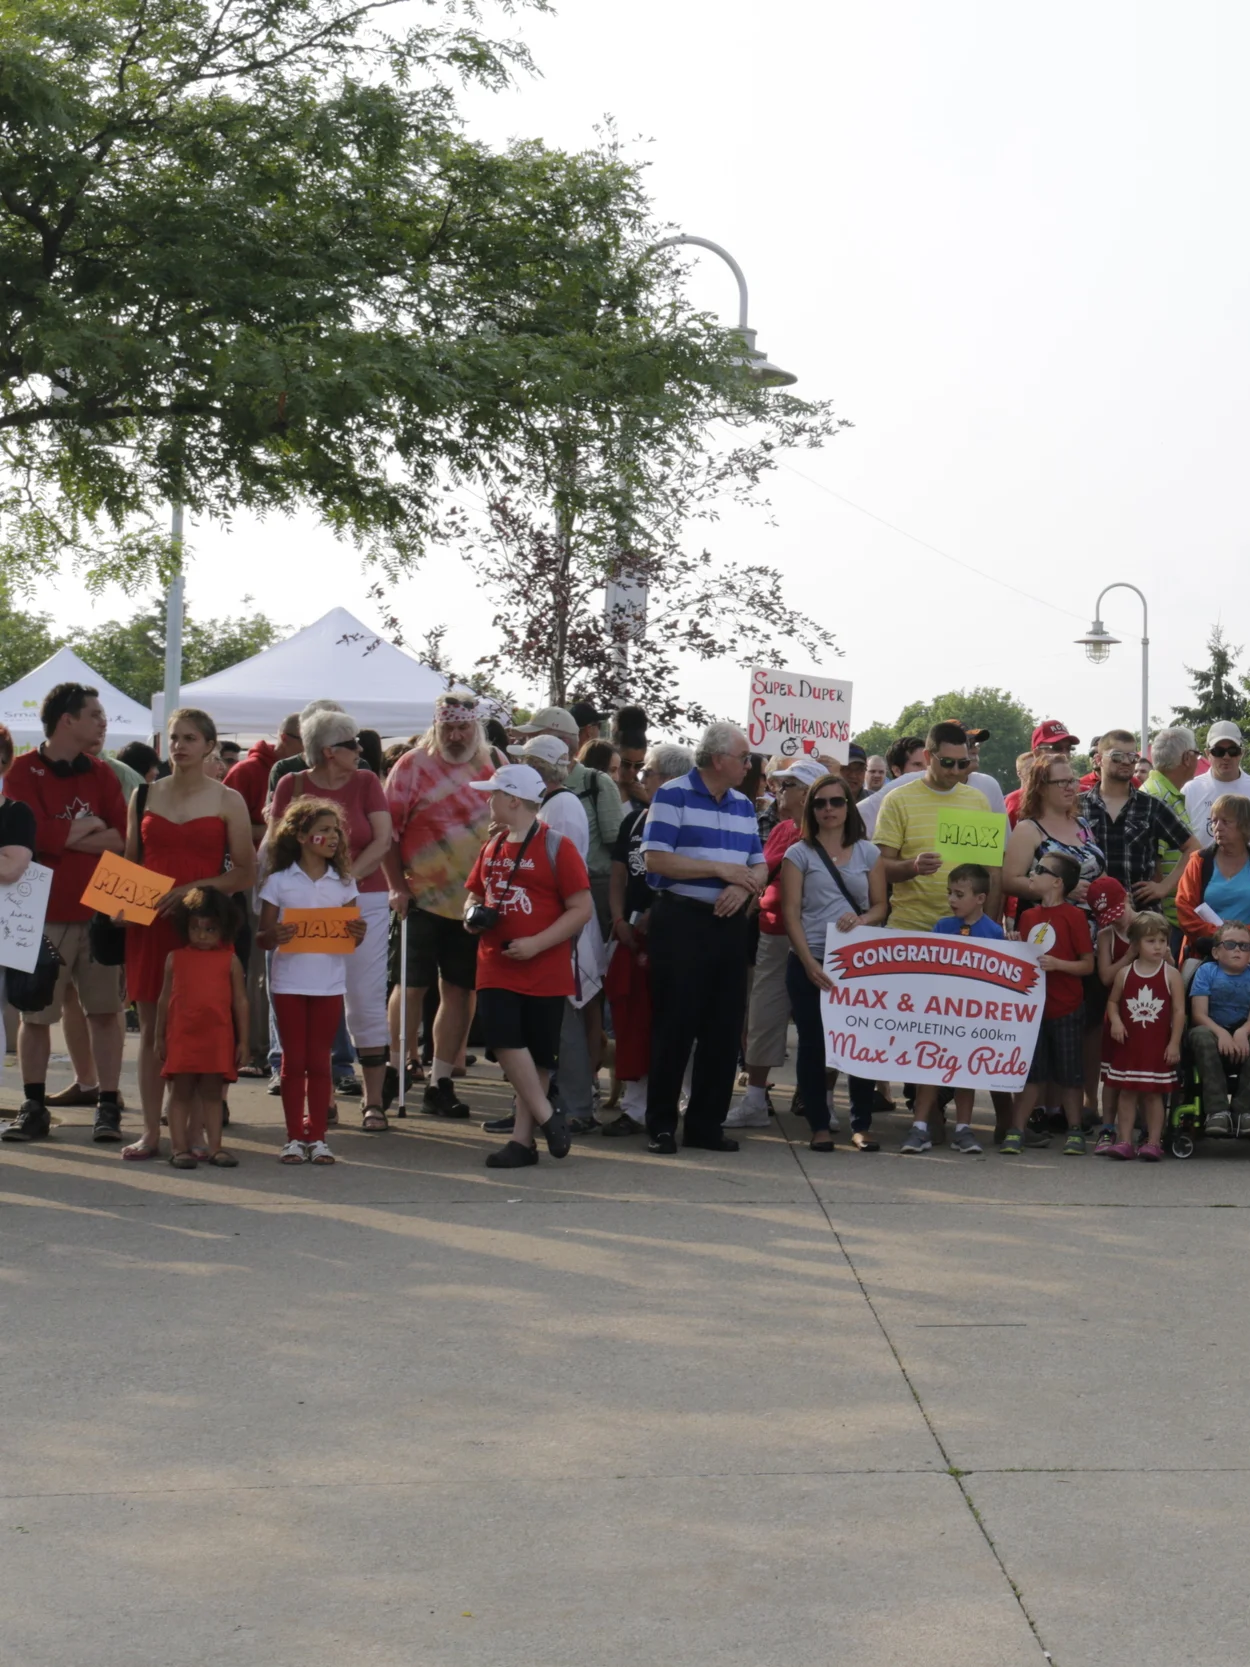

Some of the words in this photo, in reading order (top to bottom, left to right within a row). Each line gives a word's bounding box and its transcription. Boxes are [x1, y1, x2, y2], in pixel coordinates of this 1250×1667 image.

[799, 680, 844, 702] DUPER
[939, 822, 999, 849] MAX
[94, 868, 161, 911] MAX
[852, 944, 1022, 983] CONGRATULATIONS
[829, 986, 889, 1010] MAX
[897, 993, 915, 1012] &
[924, 996, 1038, 1023] ANDREW
[1132, 1002, 1157, 1012] CANADA
[845, 1015, 869, 1028] ON
[874, 1018, 966, 1038] COMPLETING
[971, 1028, 1017, 1042] 600km
[828, 1030, 912, 1067] Max's
[915, 1041, 962, 1084] Big
[967, 1046, 1028, 1076] Ride
